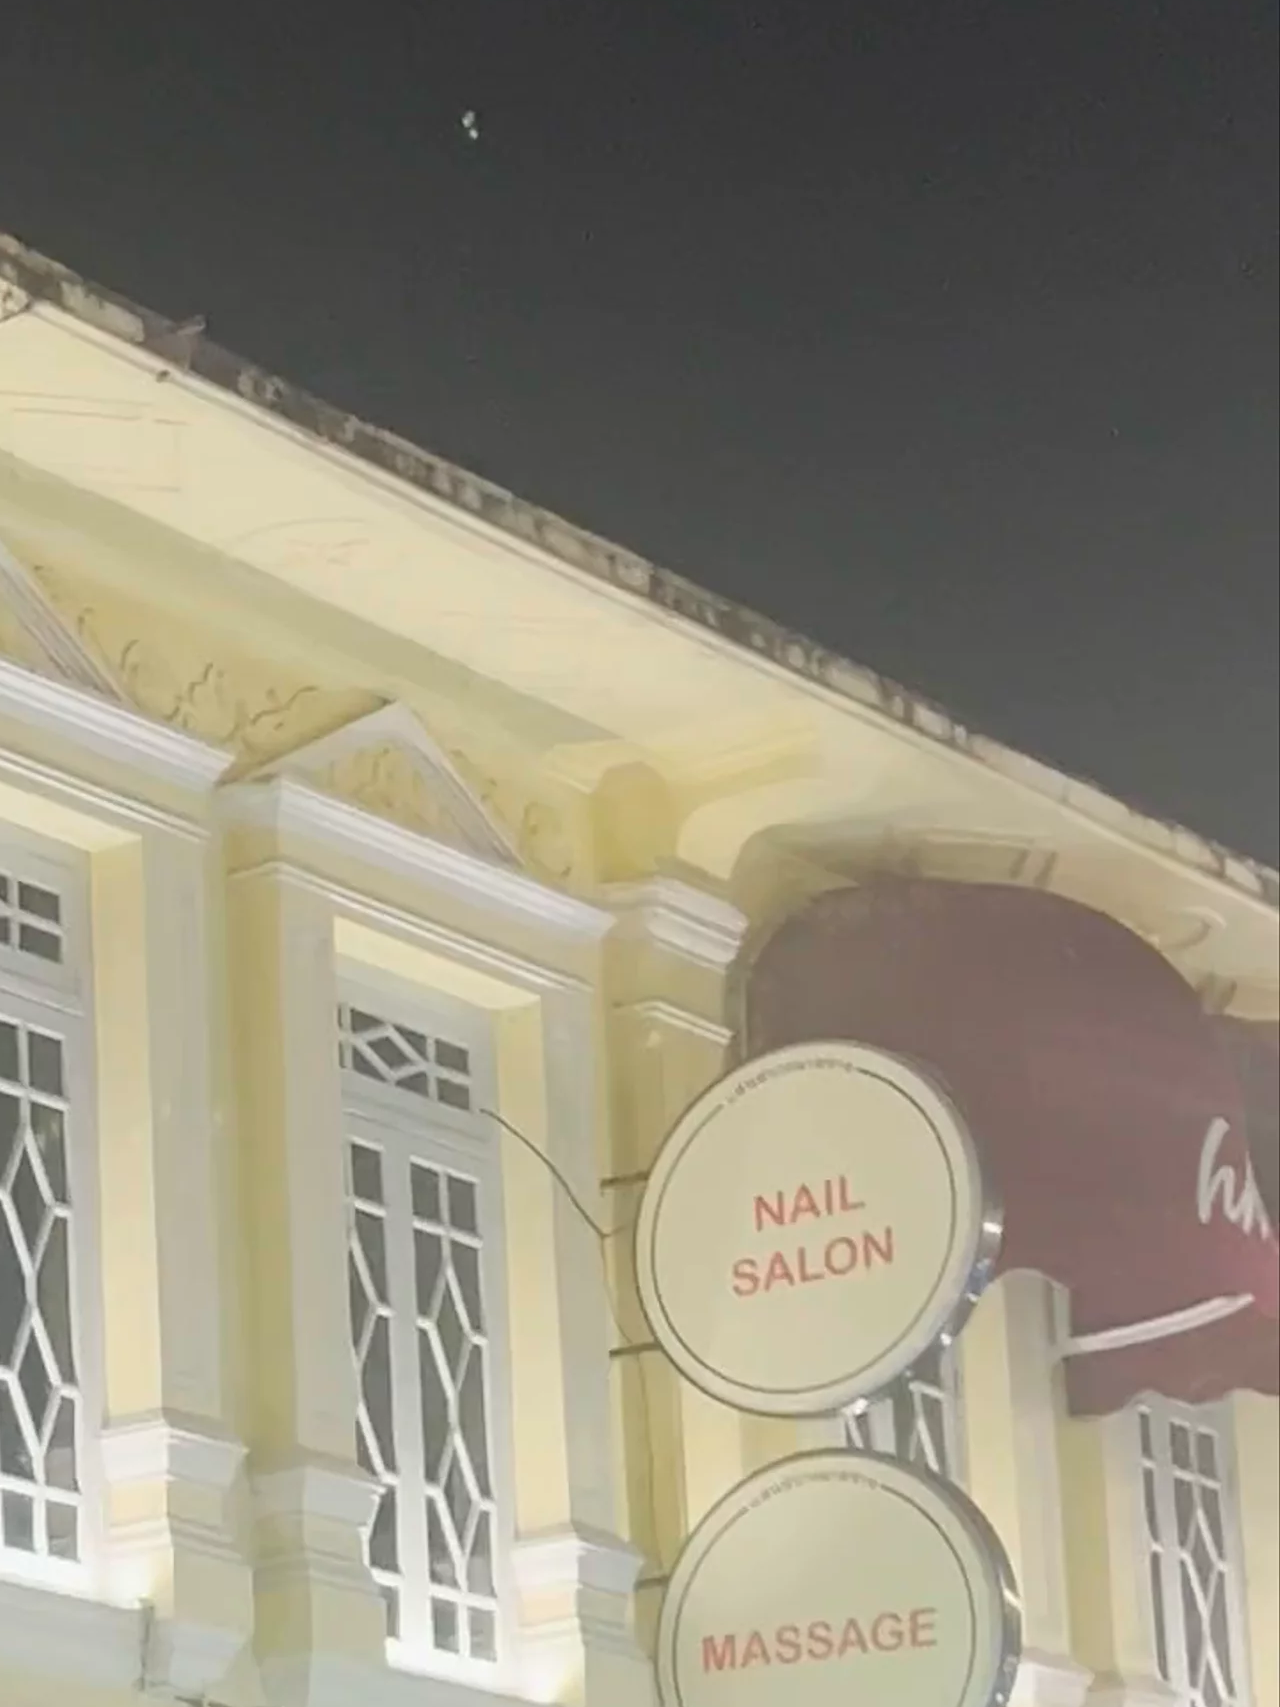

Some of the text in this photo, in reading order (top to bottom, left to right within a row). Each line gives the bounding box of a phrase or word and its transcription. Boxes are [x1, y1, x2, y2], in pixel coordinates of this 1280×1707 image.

[753, 1174, 867, 1233] NAIL
[732, 1225, 894, 1297] SALON
[701, 1606, 939, 1675] MASSAGE
